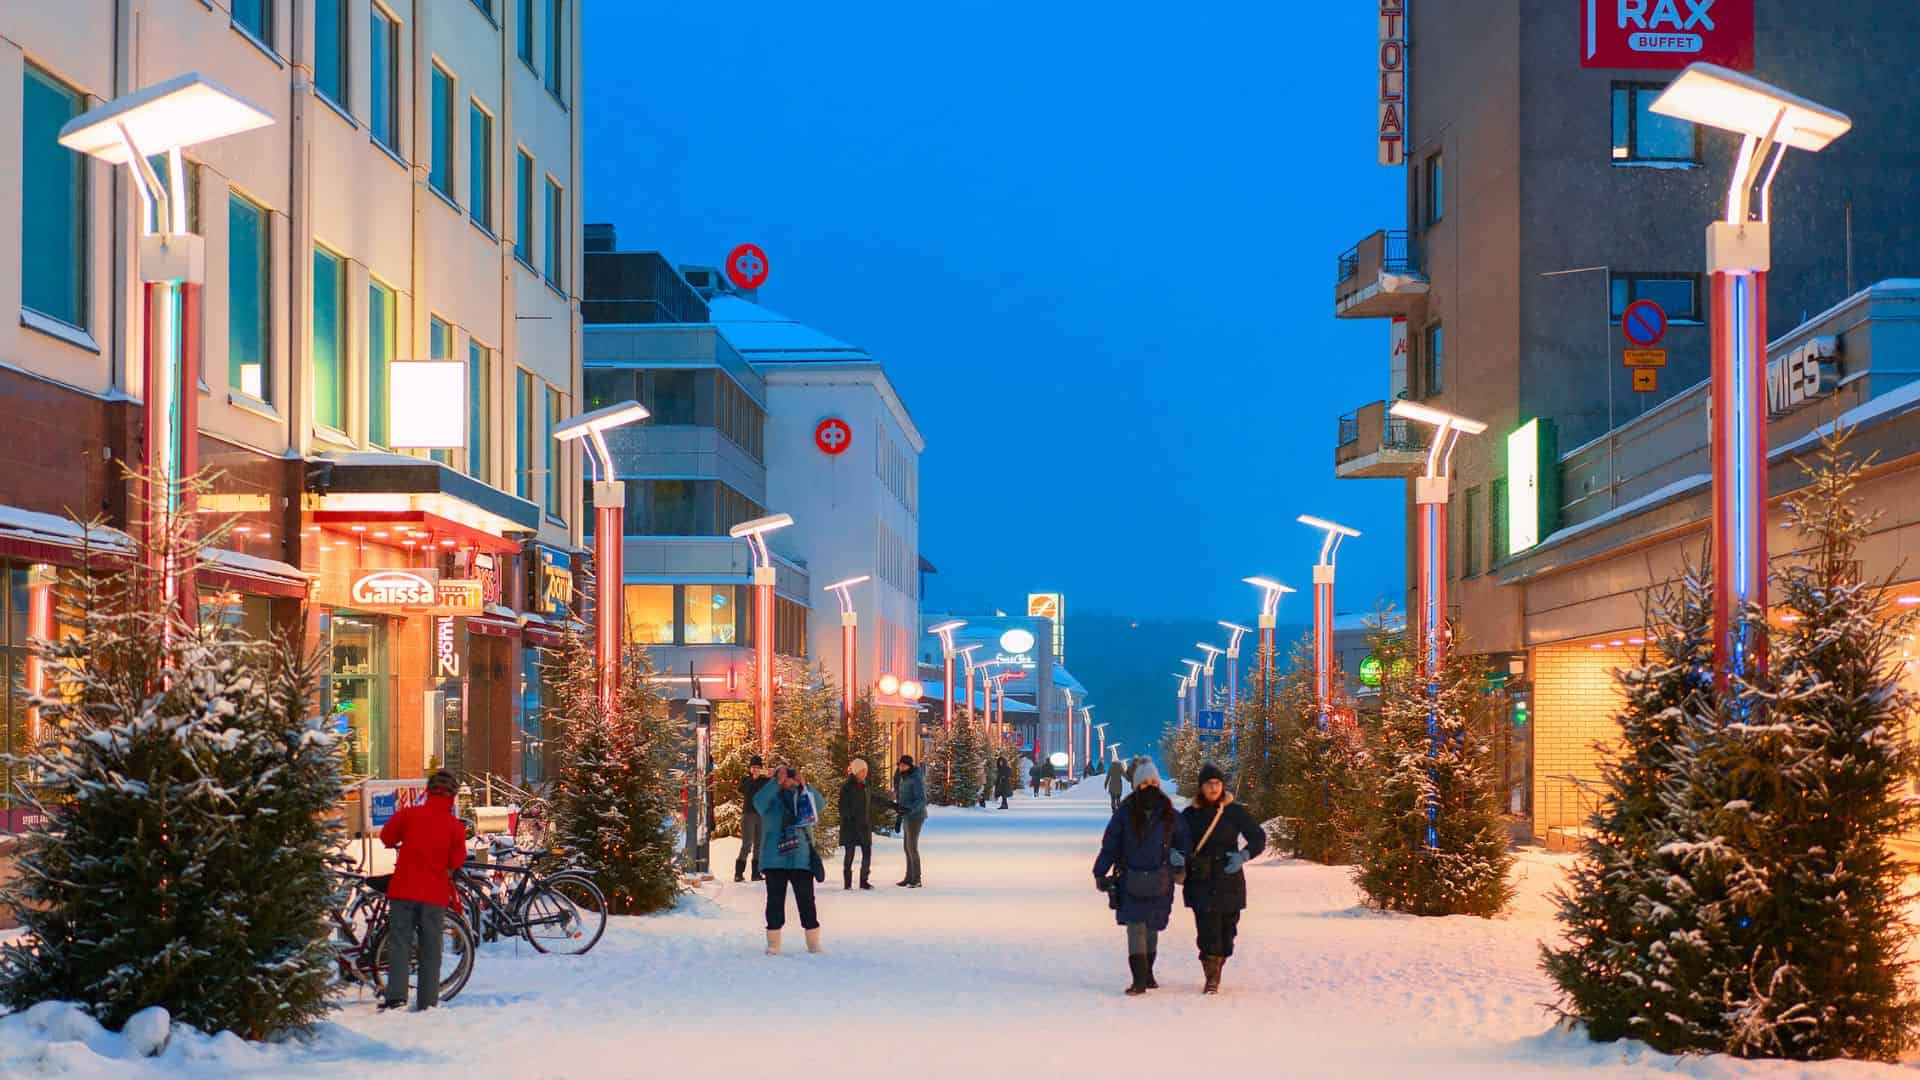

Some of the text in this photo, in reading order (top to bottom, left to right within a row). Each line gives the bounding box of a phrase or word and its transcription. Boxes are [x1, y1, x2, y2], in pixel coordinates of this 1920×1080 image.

[1617, 0, 1715, 30] RAX
[1639, 37, 1694, 49] BUFFET
[1381, 0, 1401, 163] TOLAT
[352, 572, 435, 604] Gaissa
